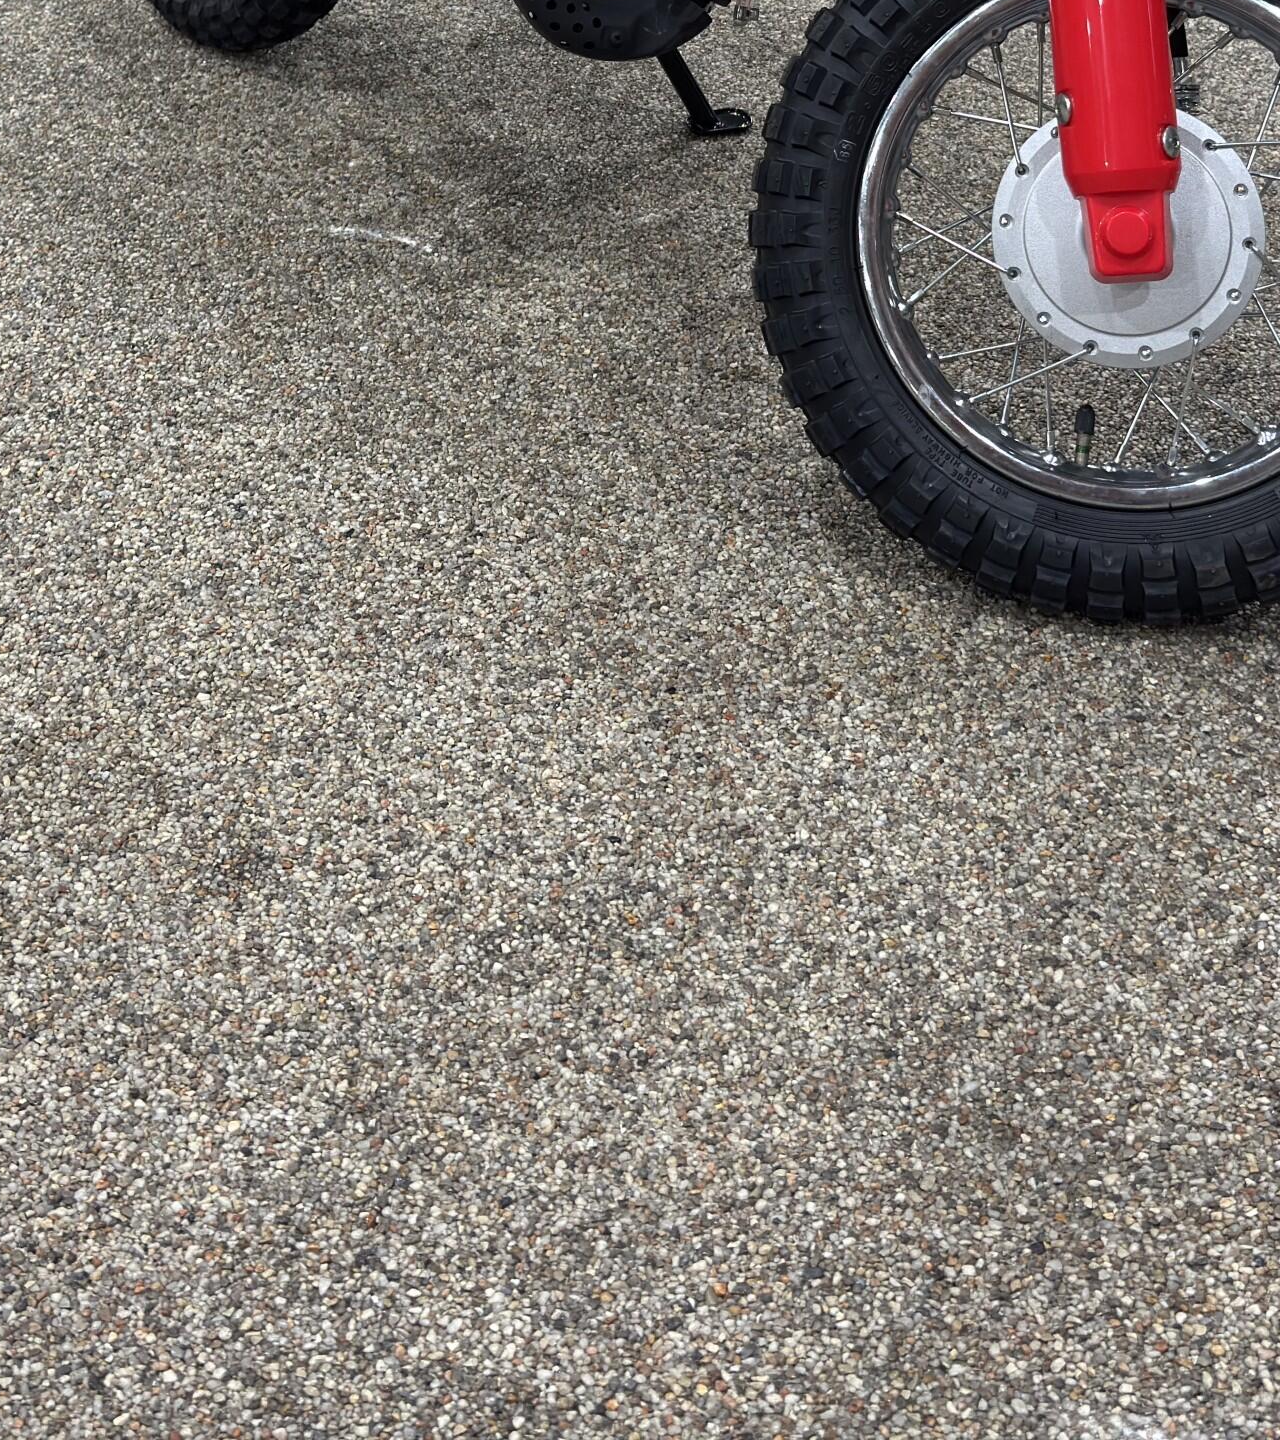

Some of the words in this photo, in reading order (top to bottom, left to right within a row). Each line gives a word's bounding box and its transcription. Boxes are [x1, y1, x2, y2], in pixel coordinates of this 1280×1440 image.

[922, 433, 963, 469] HIGHWAY
[964, 466, 986, 485] FOR
[988, 482, 1010, 500] NOT
